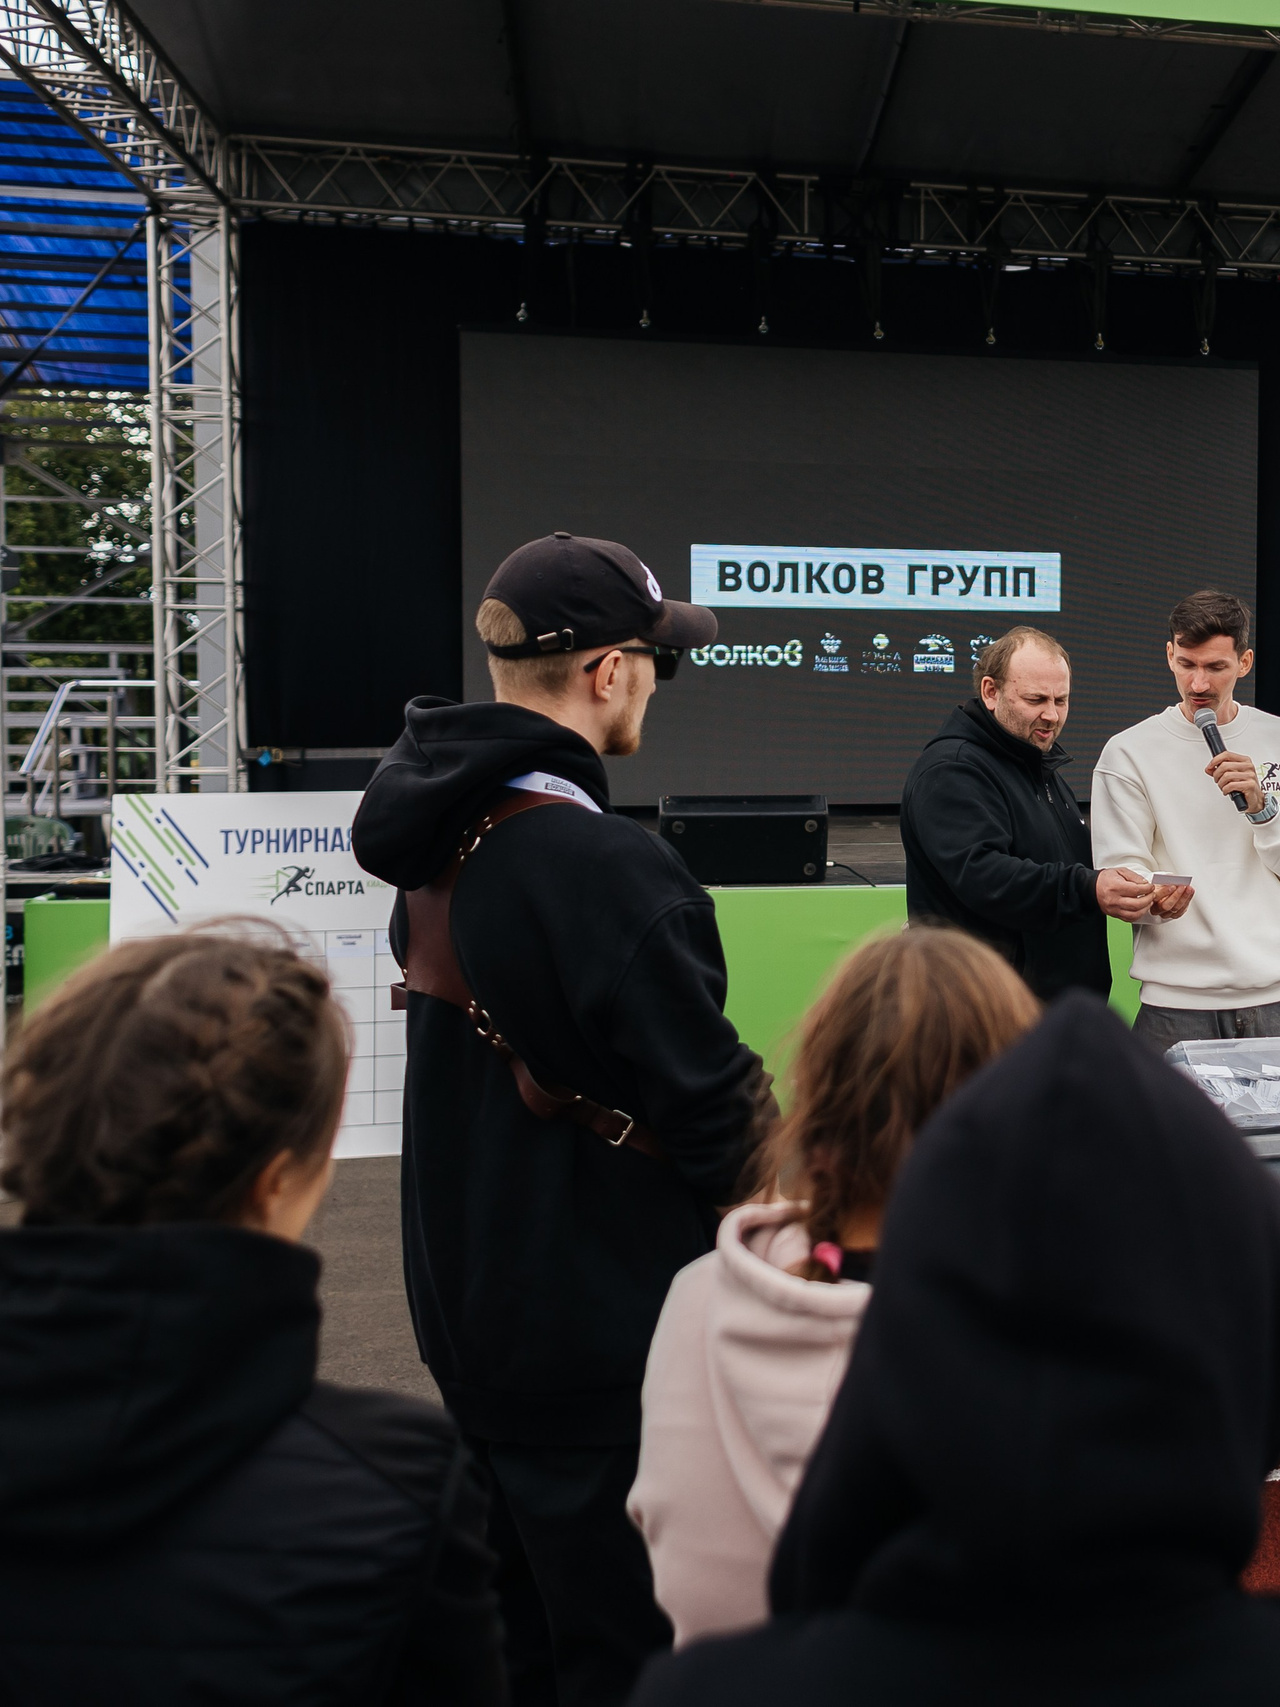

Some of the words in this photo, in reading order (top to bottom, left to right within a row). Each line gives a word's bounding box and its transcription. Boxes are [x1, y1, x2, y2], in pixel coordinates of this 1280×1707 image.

[717, 560, 885, 595] ВОЛКОВ
[907, 564, 1036, 597] ГРУПП
[1261, 781, 1280, 791] АРТА
[305, 880, 365, 896] СПАРТА
